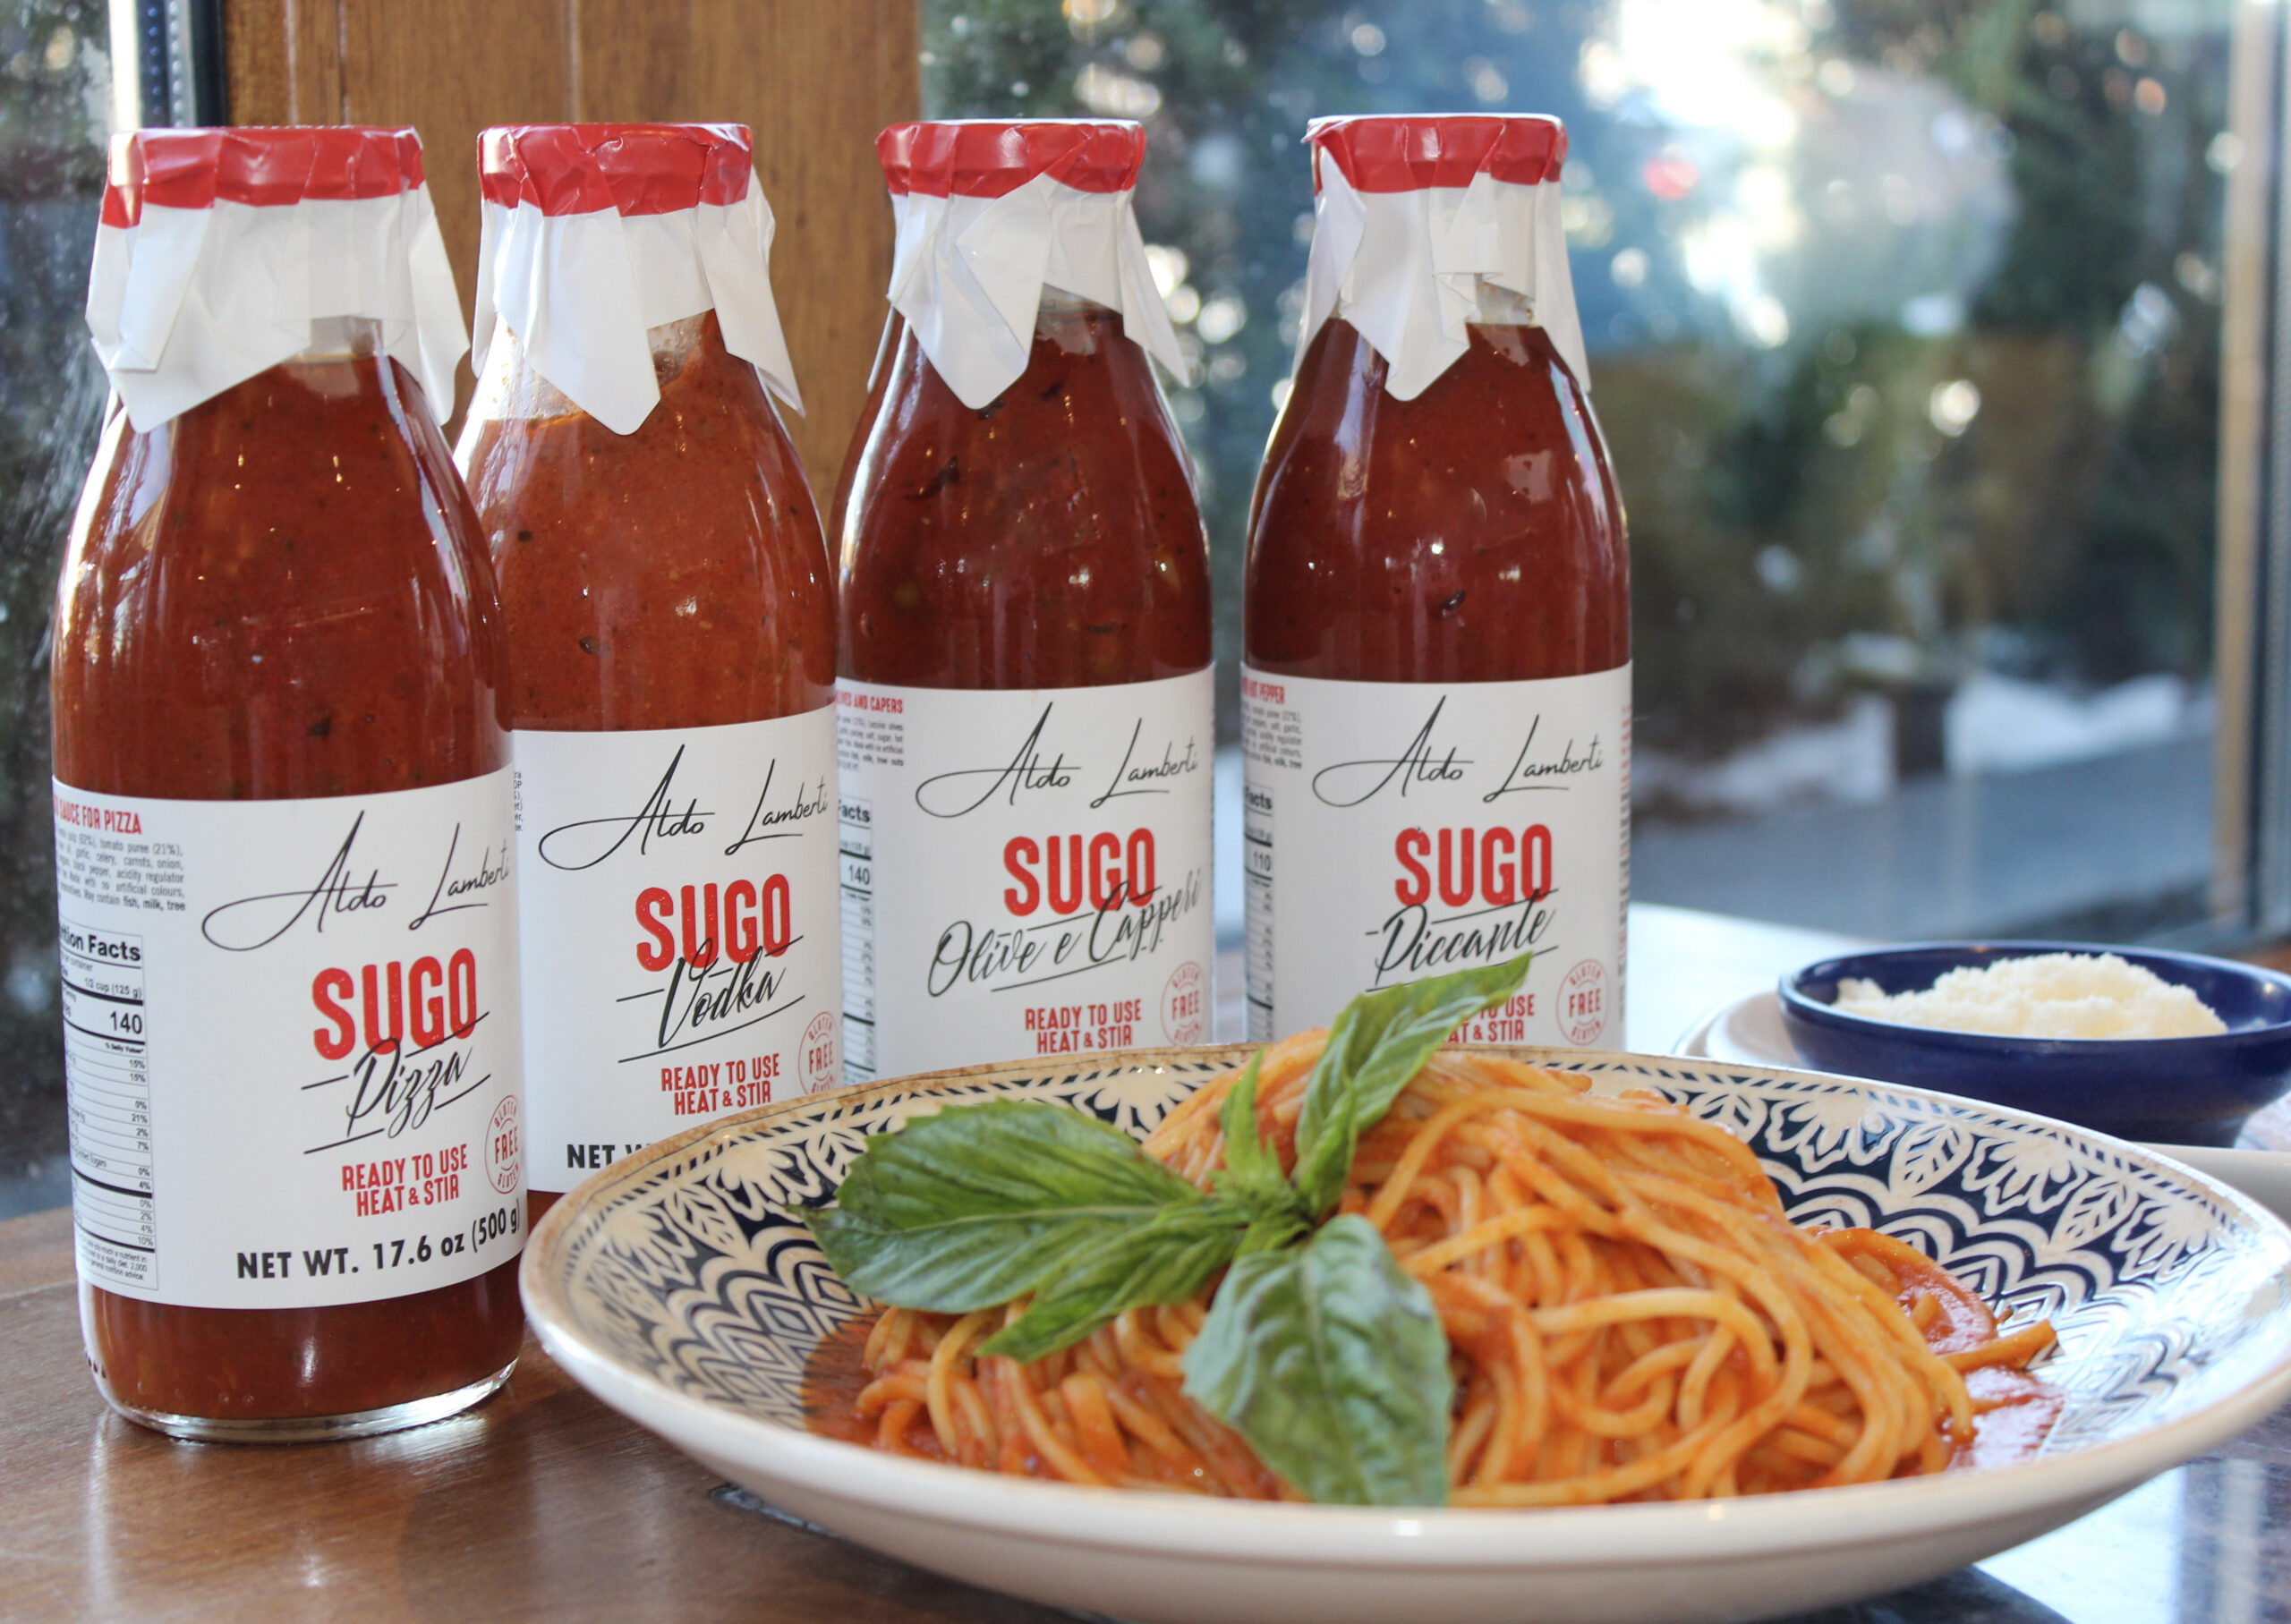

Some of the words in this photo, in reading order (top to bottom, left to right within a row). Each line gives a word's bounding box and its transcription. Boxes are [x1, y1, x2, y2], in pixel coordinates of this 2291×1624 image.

[870, 696, 903, 714] CAPERS
[916, 701, 1081, 818] Aldo
[1089, 718, 1199, 810] Lamberti
[1313, 694, 1475, 807] Aldo
[1482, 714, 1604, 803] Lamberti
[82, 805, 101, 829] FOR
[104, 809, 142, 835] PIZZA
[539, 744, 715, 871] Aldo
[724, 759, 829, 856] Lamberti
[839, 799, 872, 823] acts
[202, 810, 398, 950] Aldo
[409, 821, 510, 931] Lamberti
[848, 864, 871, 886] 140
[1003, 827, 1155, 917] SUGO
[1394, 823, 1553, 908] SUGO
[166, 900, 186, 911] tree
[635, 873, 791, 973] SUGO
[88, 933, 142, 962] Facts
[1375, 888, 1558, 987] Piccante
[928, 921, 1048, 998] Olive
[1054, 931, 1083, 965] e
[311, 948, 479, 1061] SUGO
[658, 937, 787, 1050] Vodka
[1171, 990, 1200, 1022] FREE
[1505, 993, 1536, 1018] USE
[1569, 987, 1602, 1018] FREE
[110, 1011, 143, 1034] 140
[1025, 1006, 1082, 1031] READY
[1087, 1004, 1108, 1027] TO
[1113, 999, 1141, 1024] USE
[1472, 1025, 1483, 1041] &
[1487, 1018, 1525, 1042] STIR
[809, 1040, 833, 1075] FREE
[1037, 1030, 1080, 1054] HEAT
[1084, 1032, 1094, 1049] &
[1097, 1025, 1133, 1050] STIR
[345, 1038, 473, 1139] Pizza
[661, 1063, 720, 1092] READY
[726, 1059, 745, 1084] TO
[753, 1053, 779, 1080] USE
[674, 1088, 719, 1116] HEAT
[722, 1090, 733, 1107] &
[737, 1080, 771, 1108] STIR
[495, 1126, 518, 1165] FREE
[566, 1144, 616, 1169] NET
[342, 1158, 406, 1192] READY
[412, 1153, 432, 1180] TO
[439, 1144, 467, 1174] USE
[356, 1186, 405, 1217] HEAT
[408, 1187, 420, 1205] &
[423, 1174, 459, 1205] STIR
[237, 1252, 292, 1279] NET
[302, 1247, 359, 1276] WT.
[373, 1235, 432, 1270] 17.6
[441, 1233, 464, 1256] oz
[472, 1208, 507, 1253] (500
